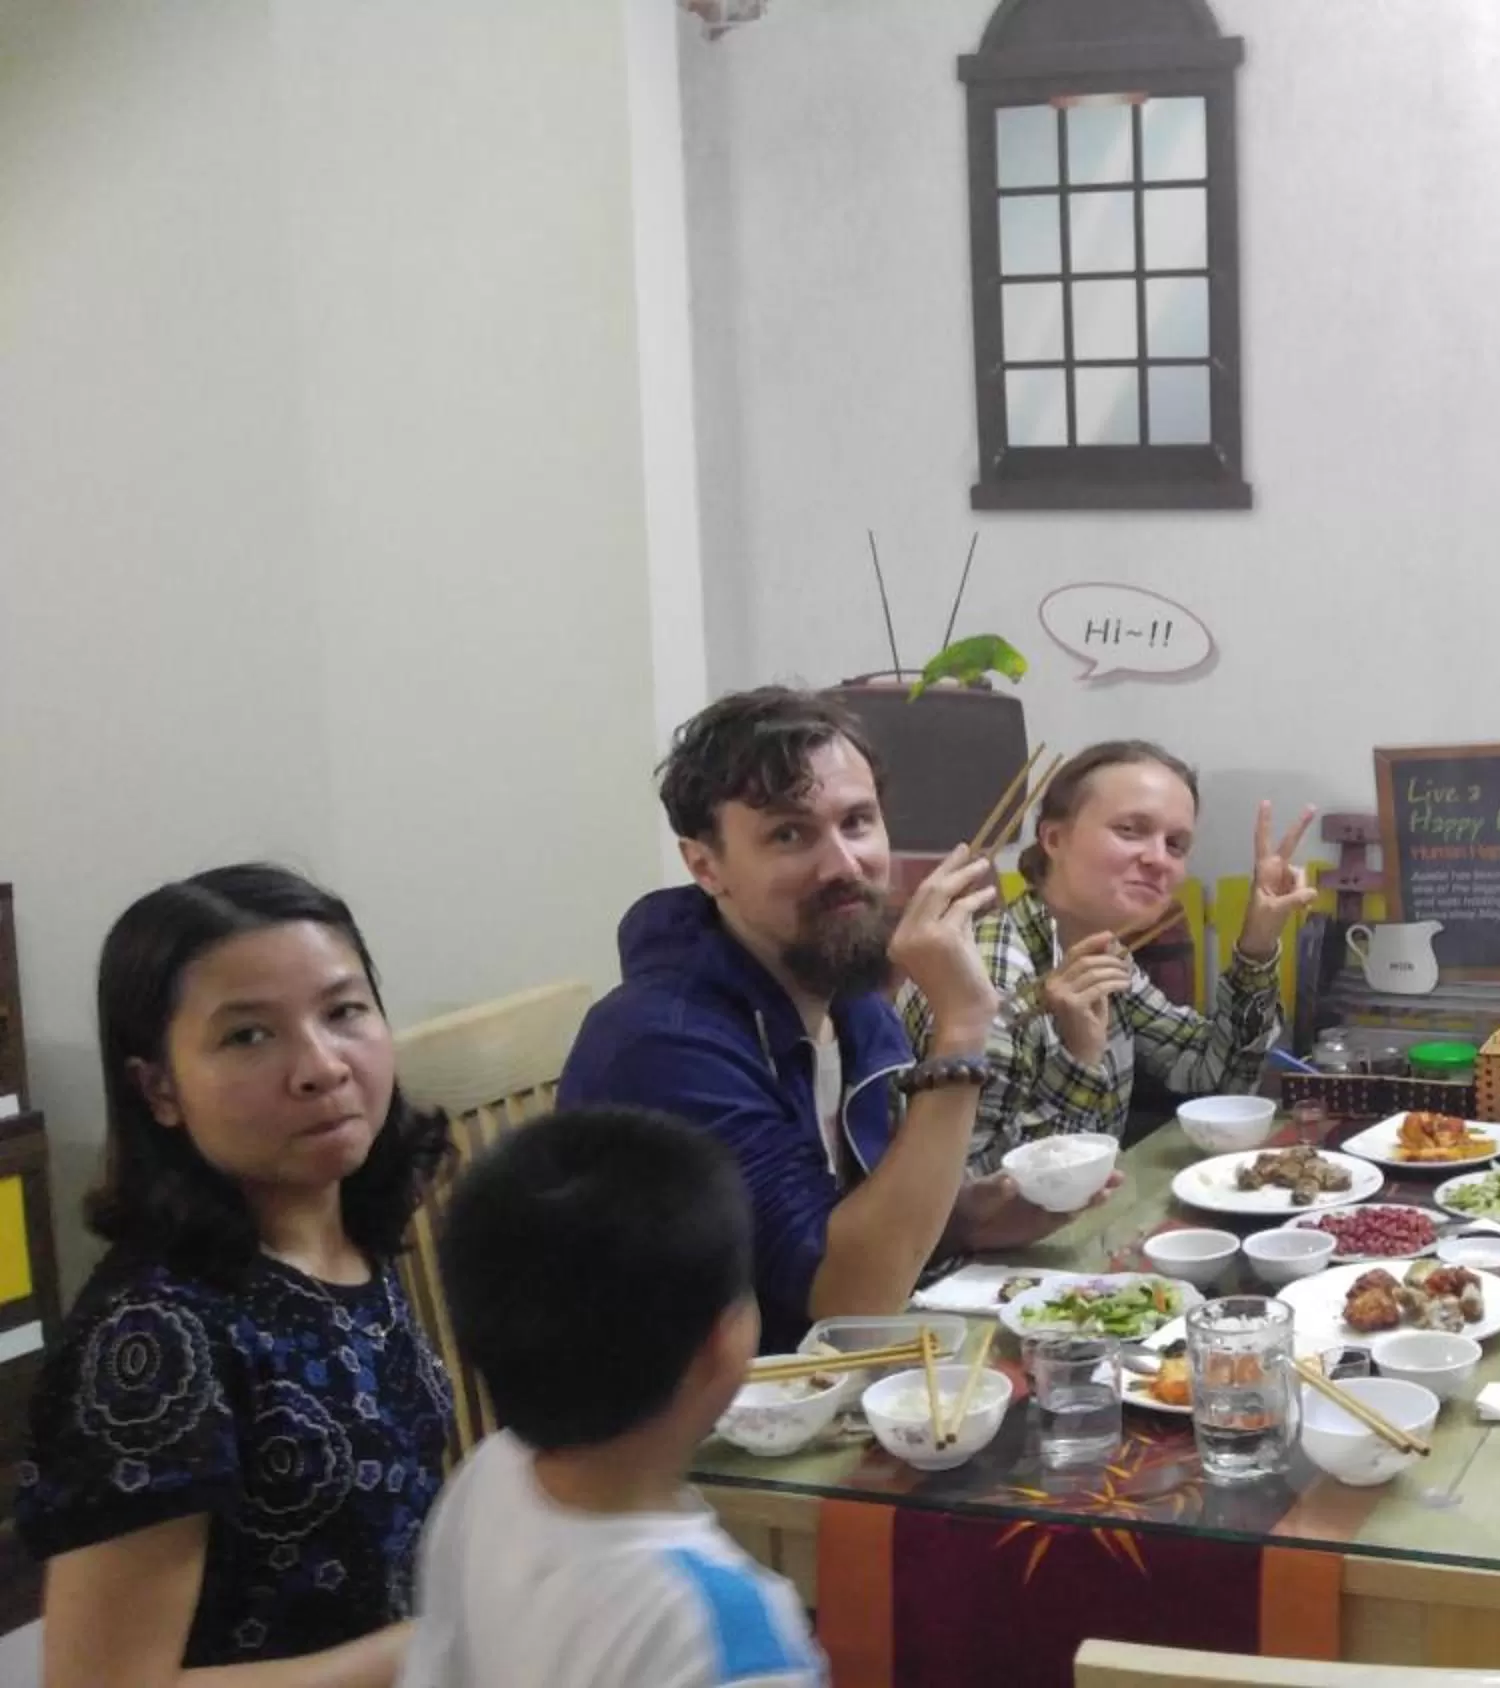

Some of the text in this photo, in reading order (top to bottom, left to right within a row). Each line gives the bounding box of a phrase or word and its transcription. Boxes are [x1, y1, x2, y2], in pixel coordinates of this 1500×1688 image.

[1408, 776, 1482, 804] Live a
[1410, 804, 1486, 842] Happy
